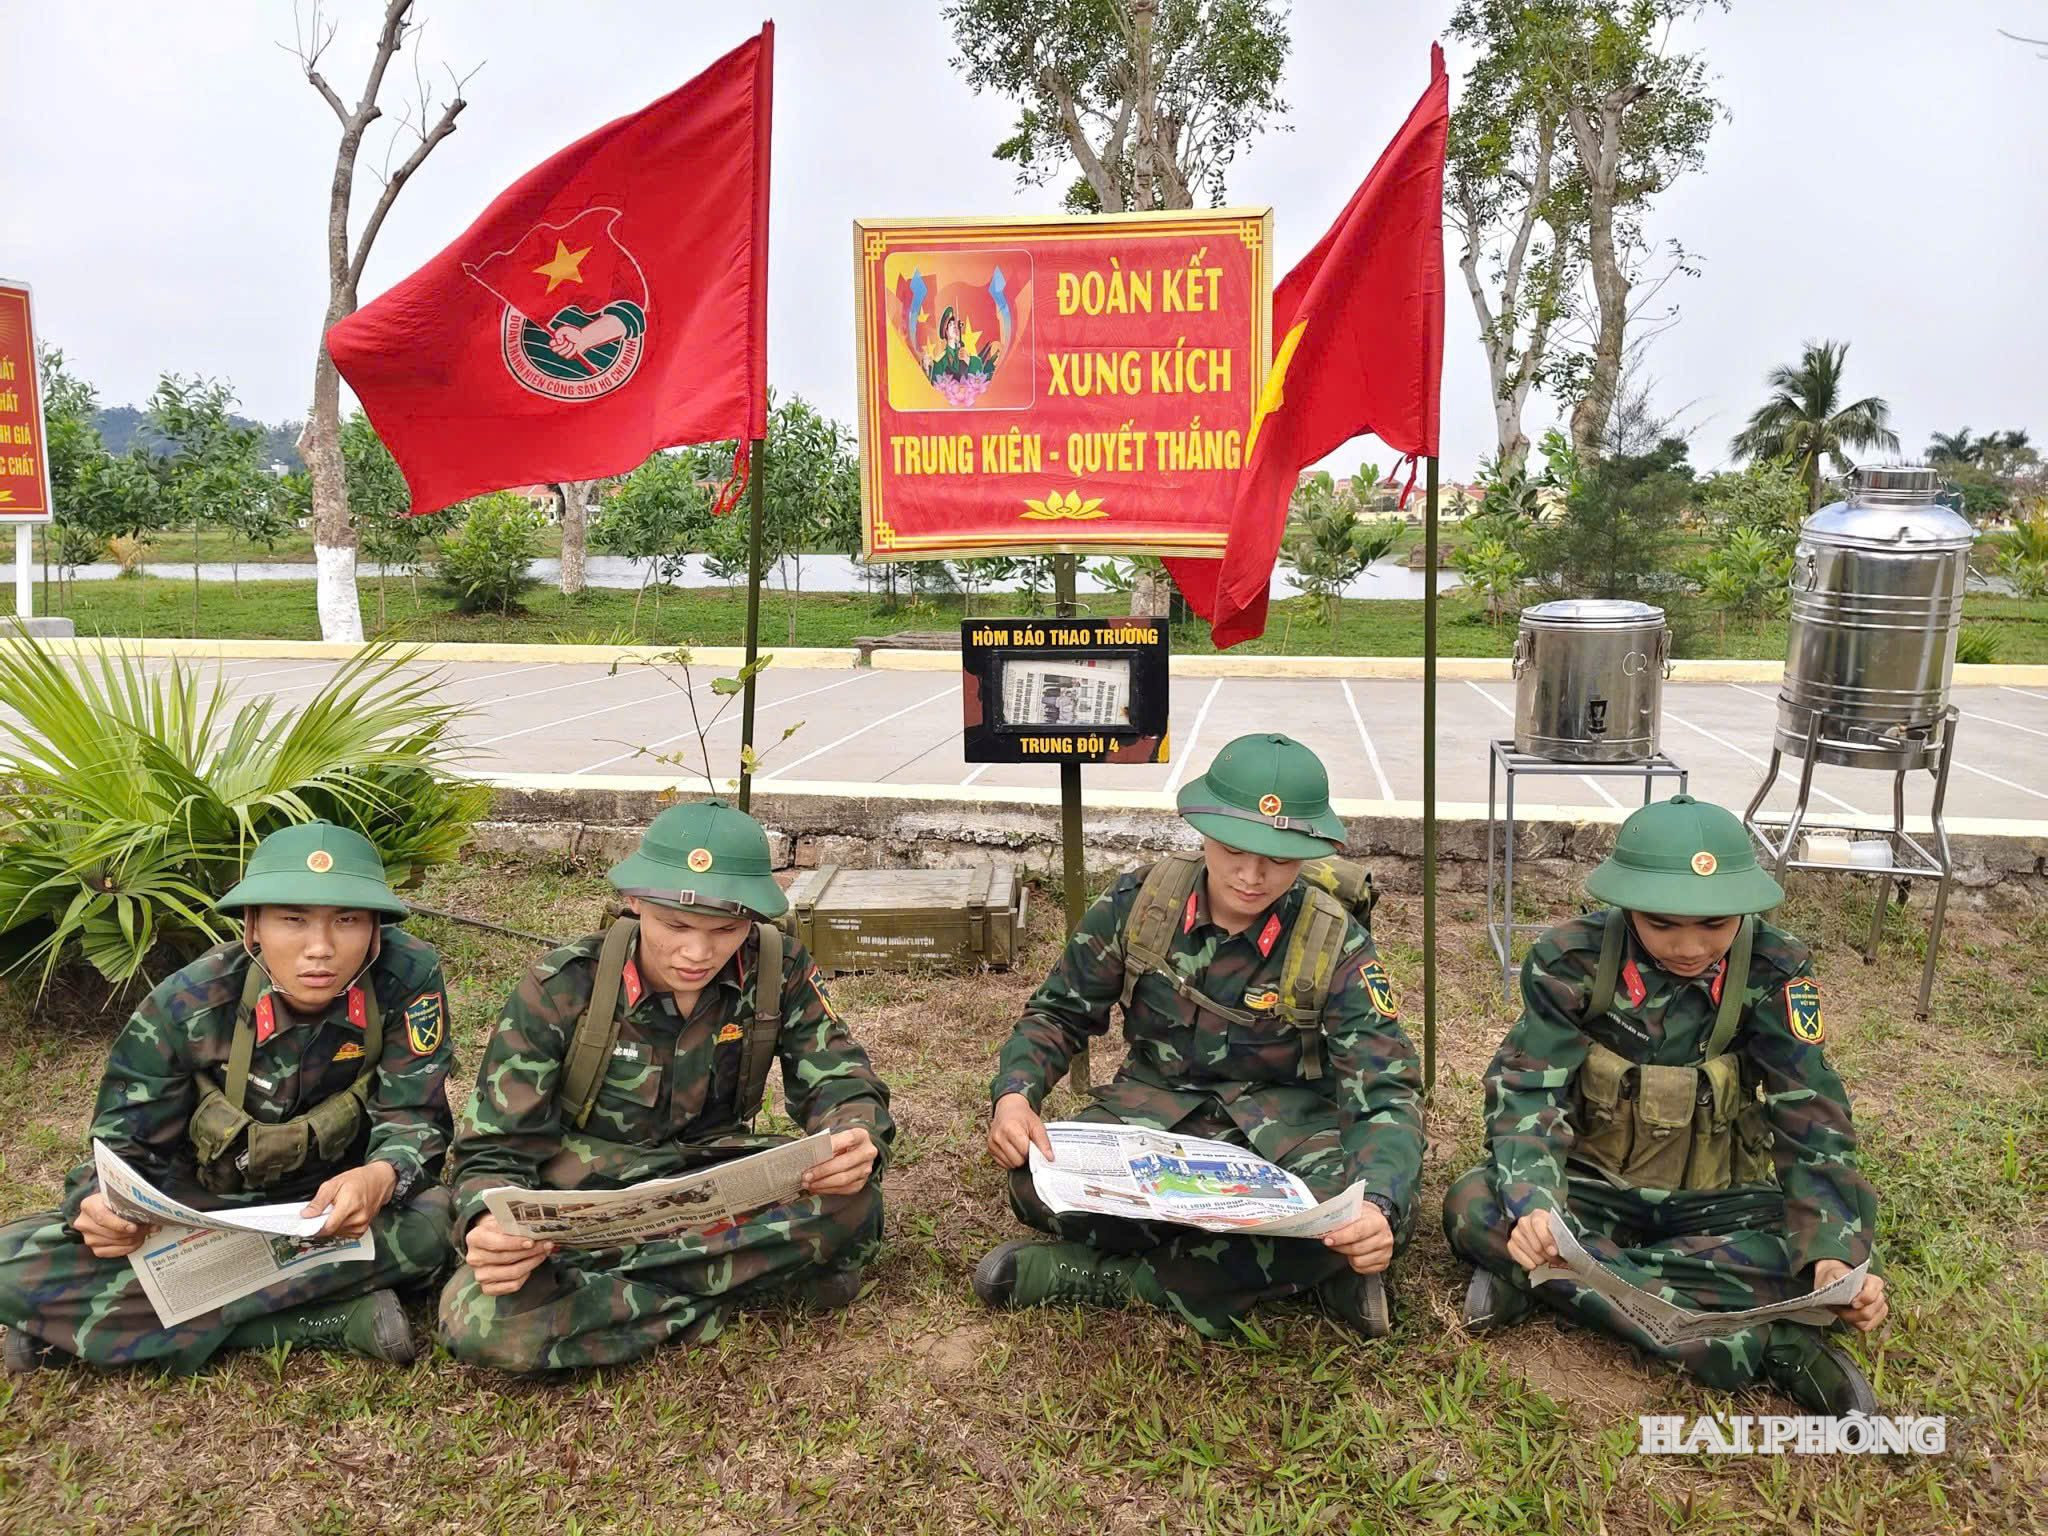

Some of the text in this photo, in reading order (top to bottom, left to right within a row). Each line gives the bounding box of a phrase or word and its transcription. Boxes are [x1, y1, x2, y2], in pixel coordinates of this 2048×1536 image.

[1057, 247, 1223, 316] ĐOÀN KẾT
[621, 339, 637, 367] MINH
[1048, 337, 1232, 397] XUNG KÍCH
[14, 422, 32, 445] GIÁ
[890, 435, 973, 476] TRUNG
[982, 426, 1041, 474] KIÊN
[1067, 419, 1147, 477] QUYẾT
[1155, 415, 1241, 472] THẮNG
[8, 451, 35, 477] CHẤT
[972, 622, 1159, 646] HÒM BÁO THAO TRƯỜNG
[1020, 733, 1120, 759] TRUNG ĐỘI 4
